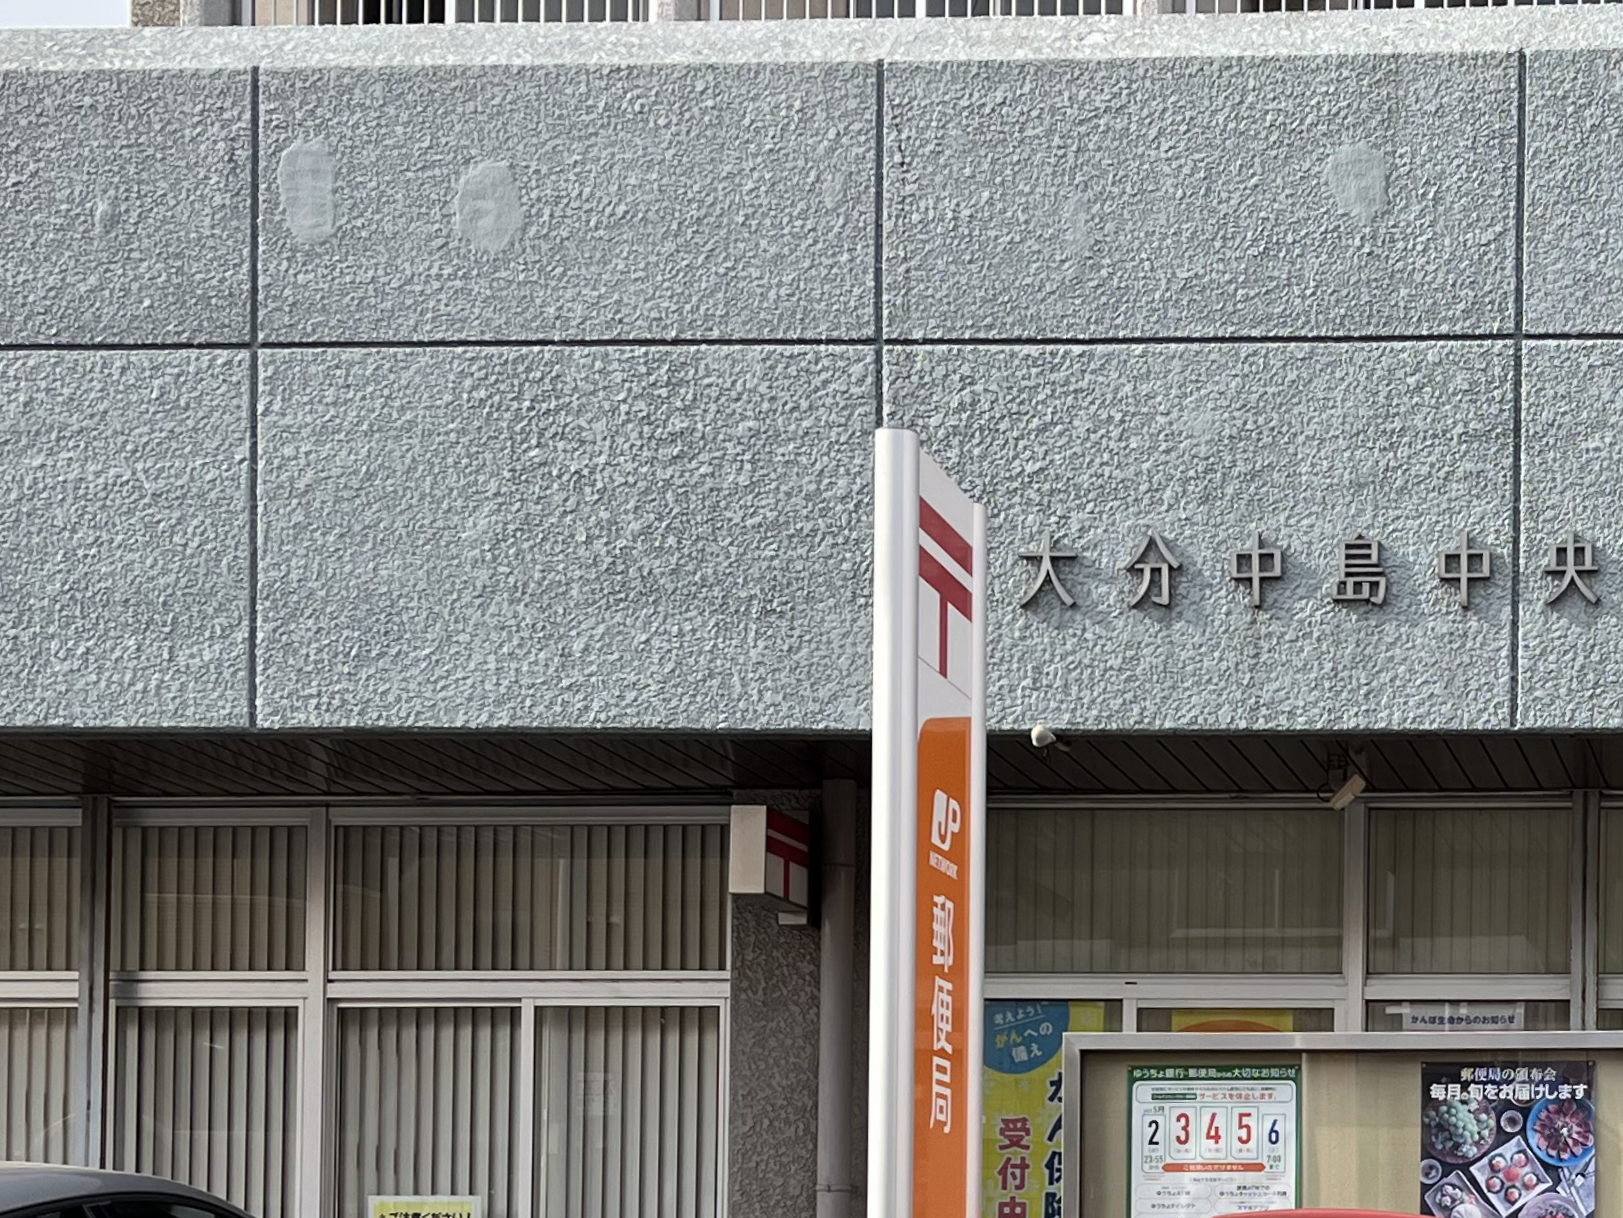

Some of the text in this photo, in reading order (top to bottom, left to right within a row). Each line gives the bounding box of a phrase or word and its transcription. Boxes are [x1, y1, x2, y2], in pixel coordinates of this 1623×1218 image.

[930, 895, 955, 1134] 郵便局
[1411, 1015, 1515, 1026] かんぽ生命からのお知らせ
[1460, 1067, 1557, 1082] 郵便局の頒布会
[1148, 1112, 1280, 1145] 2 3 4 5 6
